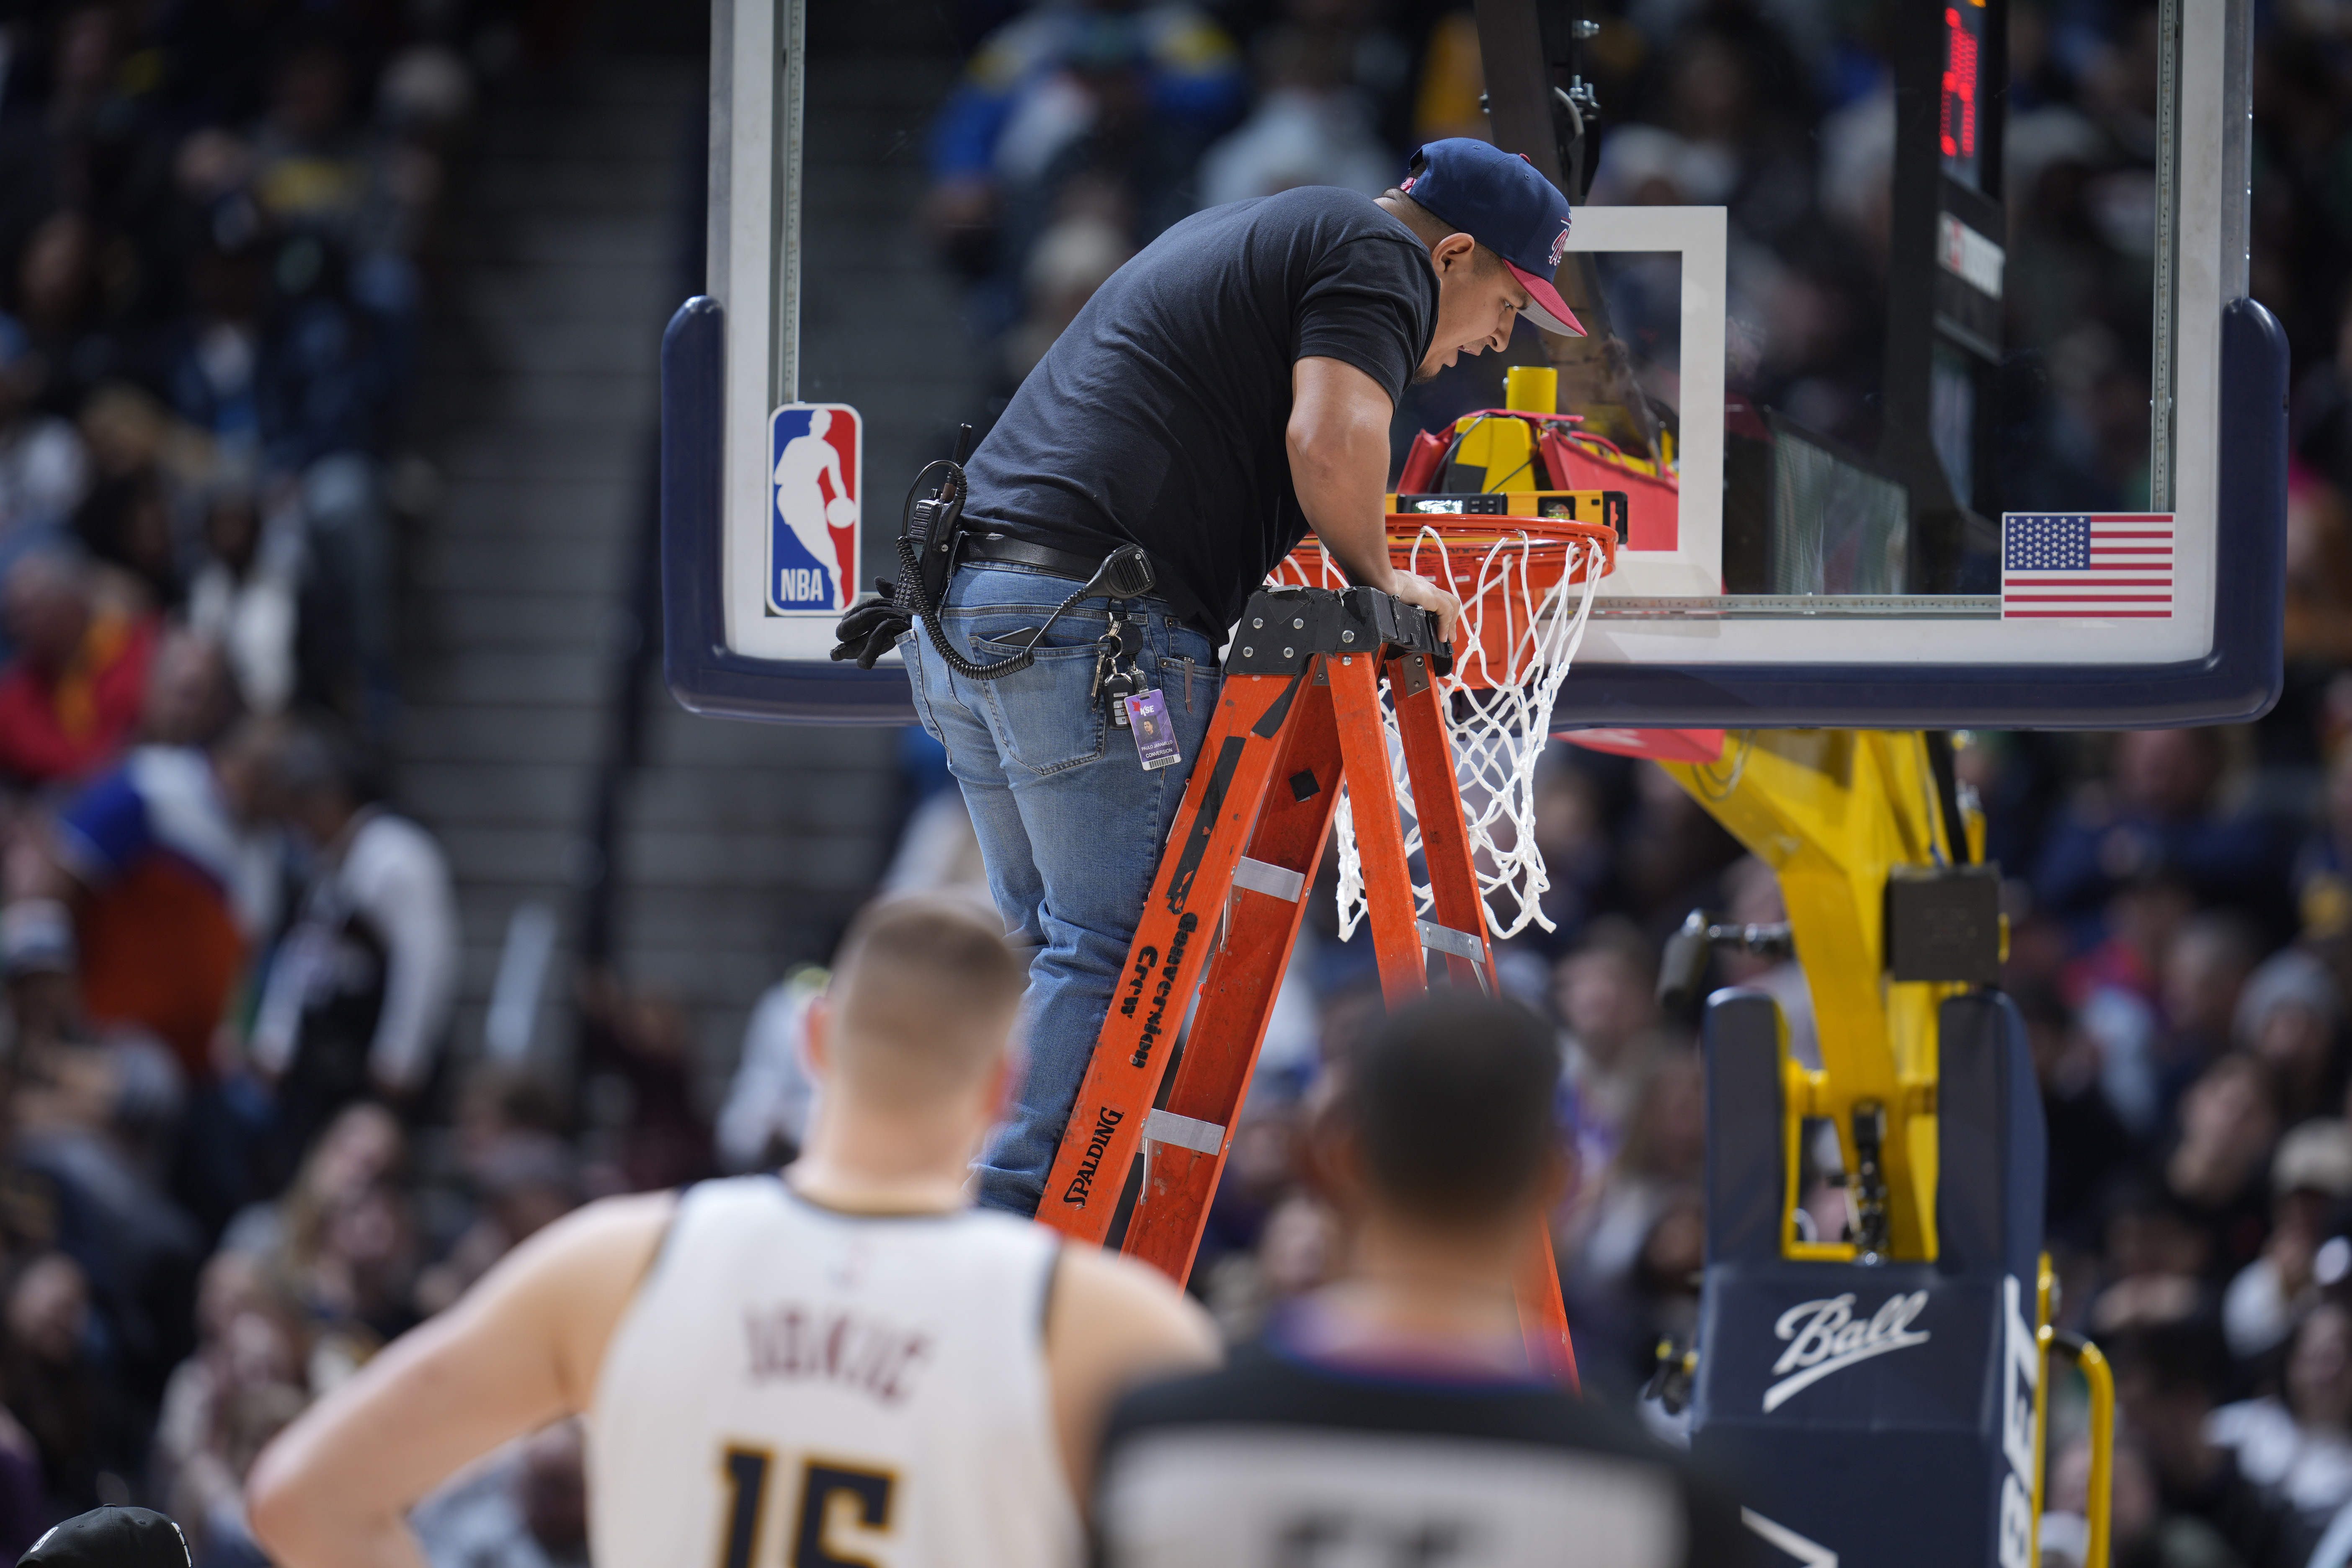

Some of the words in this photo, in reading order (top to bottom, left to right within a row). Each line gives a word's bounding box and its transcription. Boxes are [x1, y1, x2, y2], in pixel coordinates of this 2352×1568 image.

[781, 568, 824, 601] NBA
[1139, 561, 1150, 582] MOTOROLA
[1140, 705, 1154, 716] KSE
[1145, 748, 1173, 758] CONVERSION
[1153, 740, 1173, 748] JARAMILLO
[1120, 946, 1157, 1018] Crew
[1063, 1106, 1124, 1208] SPALDING
[1762, 1289, 1930, 1413] Ball
